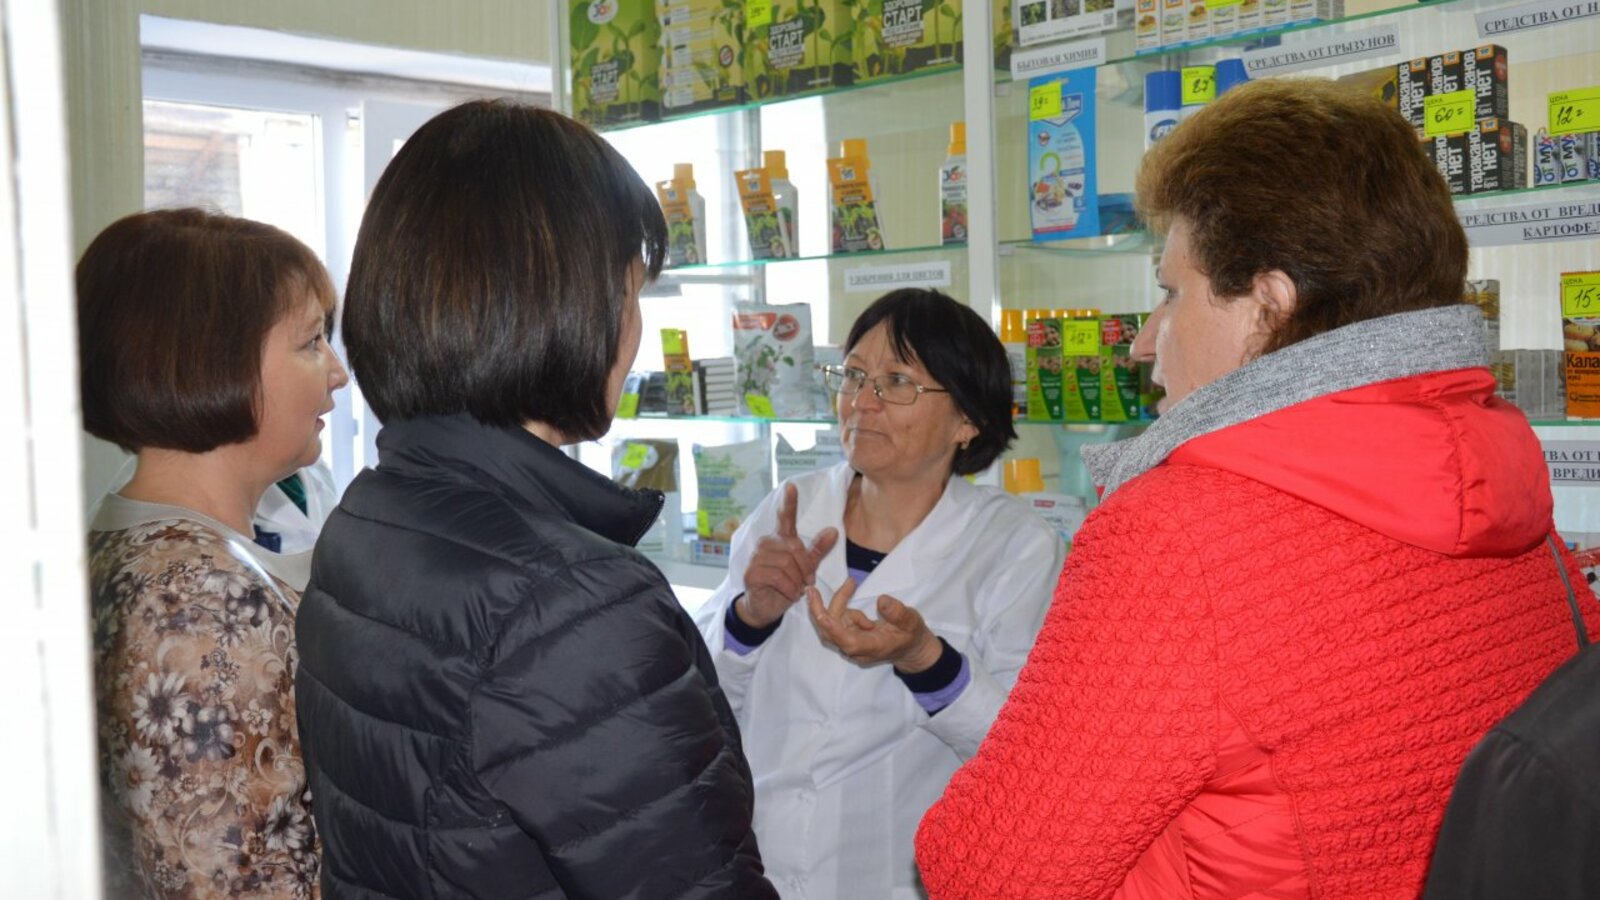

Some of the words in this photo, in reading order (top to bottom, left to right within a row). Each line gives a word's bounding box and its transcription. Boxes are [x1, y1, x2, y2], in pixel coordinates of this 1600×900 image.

[883, 6, 923, 27] СТАРТ
[1484, 10, 1559, 32] СРЕДСТВА
[1562, 4, 1584, 17] ОТ
[769, 30, 804, 50] СТАРТ
[1247, 53, 1306, 70] СРЕДСТВА
[1308, 48, 1326, 58] ОТ
[1327, 34, 1395, 55] ГРЫЗУНОВ
[1017, 53, 1061, 72] БЫТОВАЯ
[1064, 47, 1098, 63] ХИМИЯ
[1410, 81, 1425, 109] нет
[1477, 69, 1492, 97] нет
[1550, 95, 1568, 104] ЦЕНА
[1448, 147, 1463, 175] нет
[1482, 142, 1498, 170] нет
[1531, 208, 1551, 219] ОТ
[1572, 451, 1593, 461] ОТ
